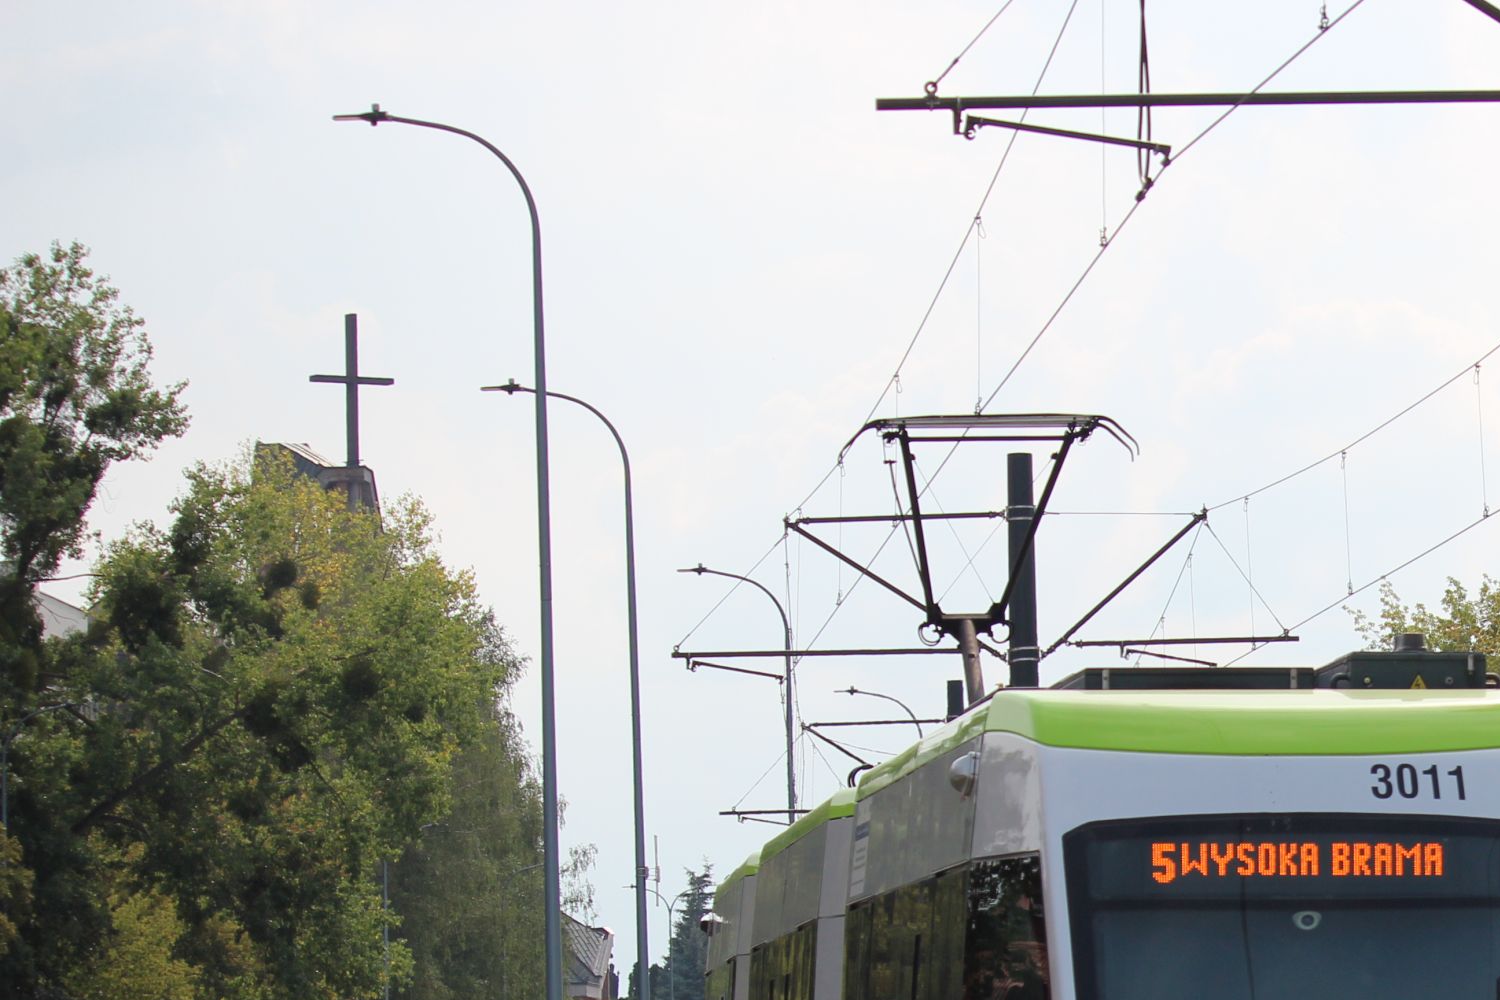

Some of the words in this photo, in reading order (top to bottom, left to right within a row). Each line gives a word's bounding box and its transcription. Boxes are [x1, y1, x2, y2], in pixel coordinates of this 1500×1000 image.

[1370, 763, 1466, 801] 3011
[1151, 842, 1176, 884] 5
[1180, 842, 1320, 877] WYSOKA
[1331, 842, 1444, 877] BRAMA
